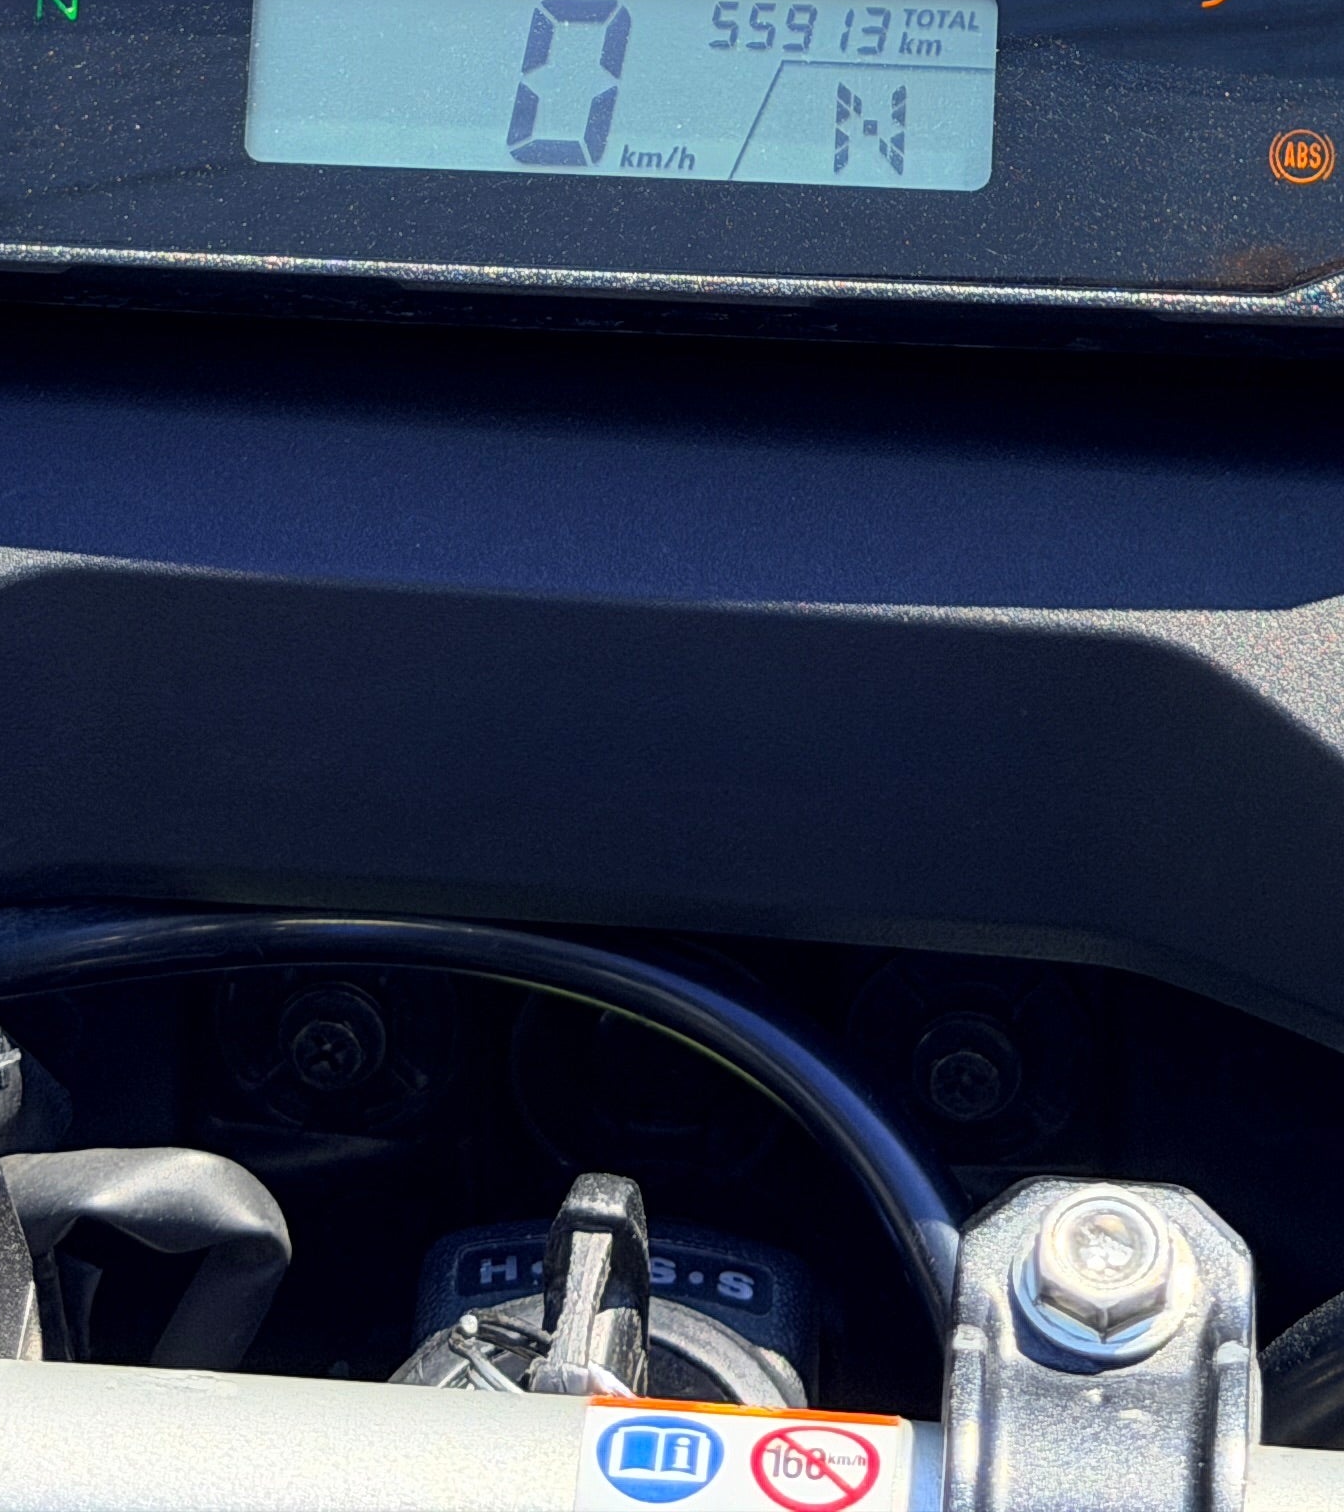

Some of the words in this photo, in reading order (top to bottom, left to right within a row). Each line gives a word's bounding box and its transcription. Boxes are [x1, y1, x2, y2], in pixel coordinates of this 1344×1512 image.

[708, 0, 891, 56] 55913
[903, 7, 980, 33] TOTAL
[898, 31, 943, 58] km
[833, 81, 907, 177] N
[619, 144, 697, 173] km/h
[1284, 141, 1322, 169] ABS
[828, 1453, 867, 1467] km/h
